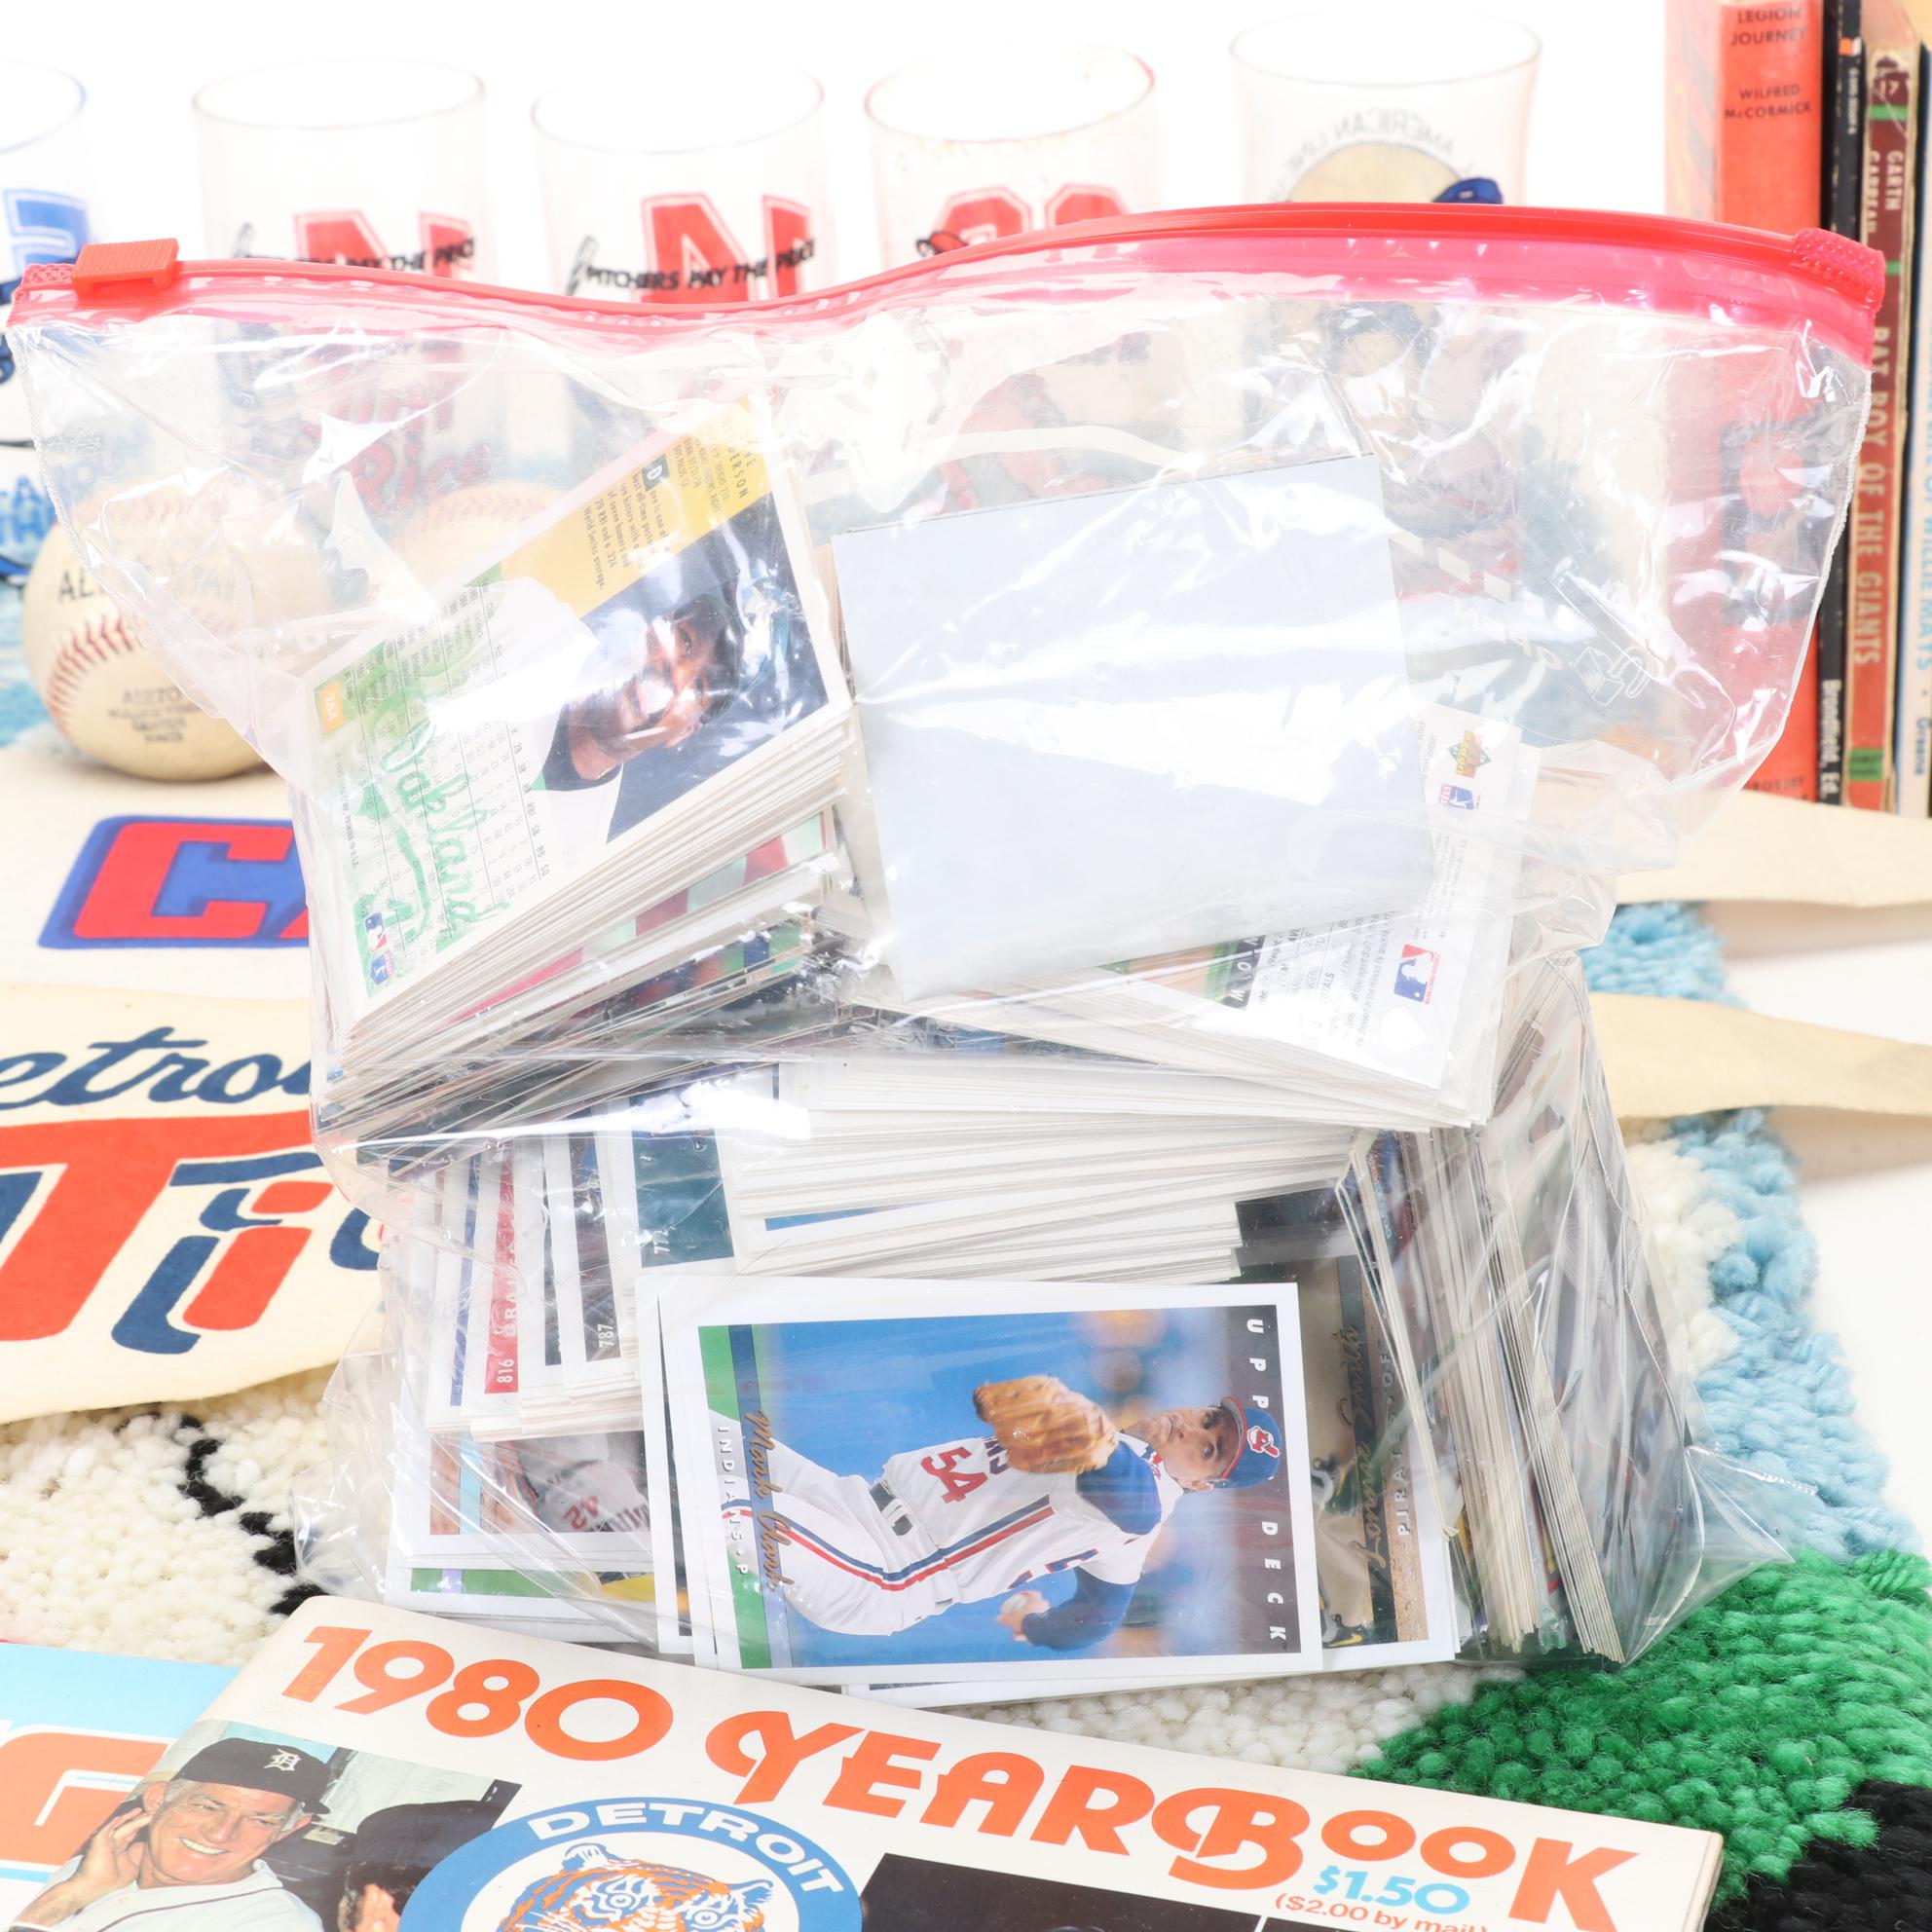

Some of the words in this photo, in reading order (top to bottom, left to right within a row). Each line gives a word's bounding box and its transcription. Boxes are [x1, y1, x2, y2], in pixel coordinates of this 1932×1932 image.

[1737, 7, 1801, 24] LEGION
[1724, 100, 1811, 120] McCORMICK
[1739, 83, 1800, 100] WILFRED
[1886, 150, 1904, 211] GARTH
[732, 258, 768, 283] THE
[1868, 390, 1888, 449] BOY
[1861, 463, 1887, 497] OF
[1858, 511, 1886, 556] THE
[1854, 572, 1883, 665] GIANTS
[0, 1026, 311, 1110] etro
[598, 1321, 616, 1349] 787
[496, 1357, 514, 1384] 816
[743, 1408, 783, 1499] Mark
[920, 1446, 987, 1504] 54
[716, 1425, 744, 1541] INDIANS
[759, 1511, 796, 1590] Clark
[1261, 1520, 1288, 1643] DECK
[280, 1625, 675, 1763] 1980
[704, 1709, 1639, 1932] YEARBOOK
[527, 1800, 845, 1896] DETROIT
[1275, 1892, 1369, 1922] ($2.00
[1373, 1910, 1409, 1930] by
[1413, 1919, 1489, 1932] mail)
[1313, 1864, 1470, 1915] $1.50
